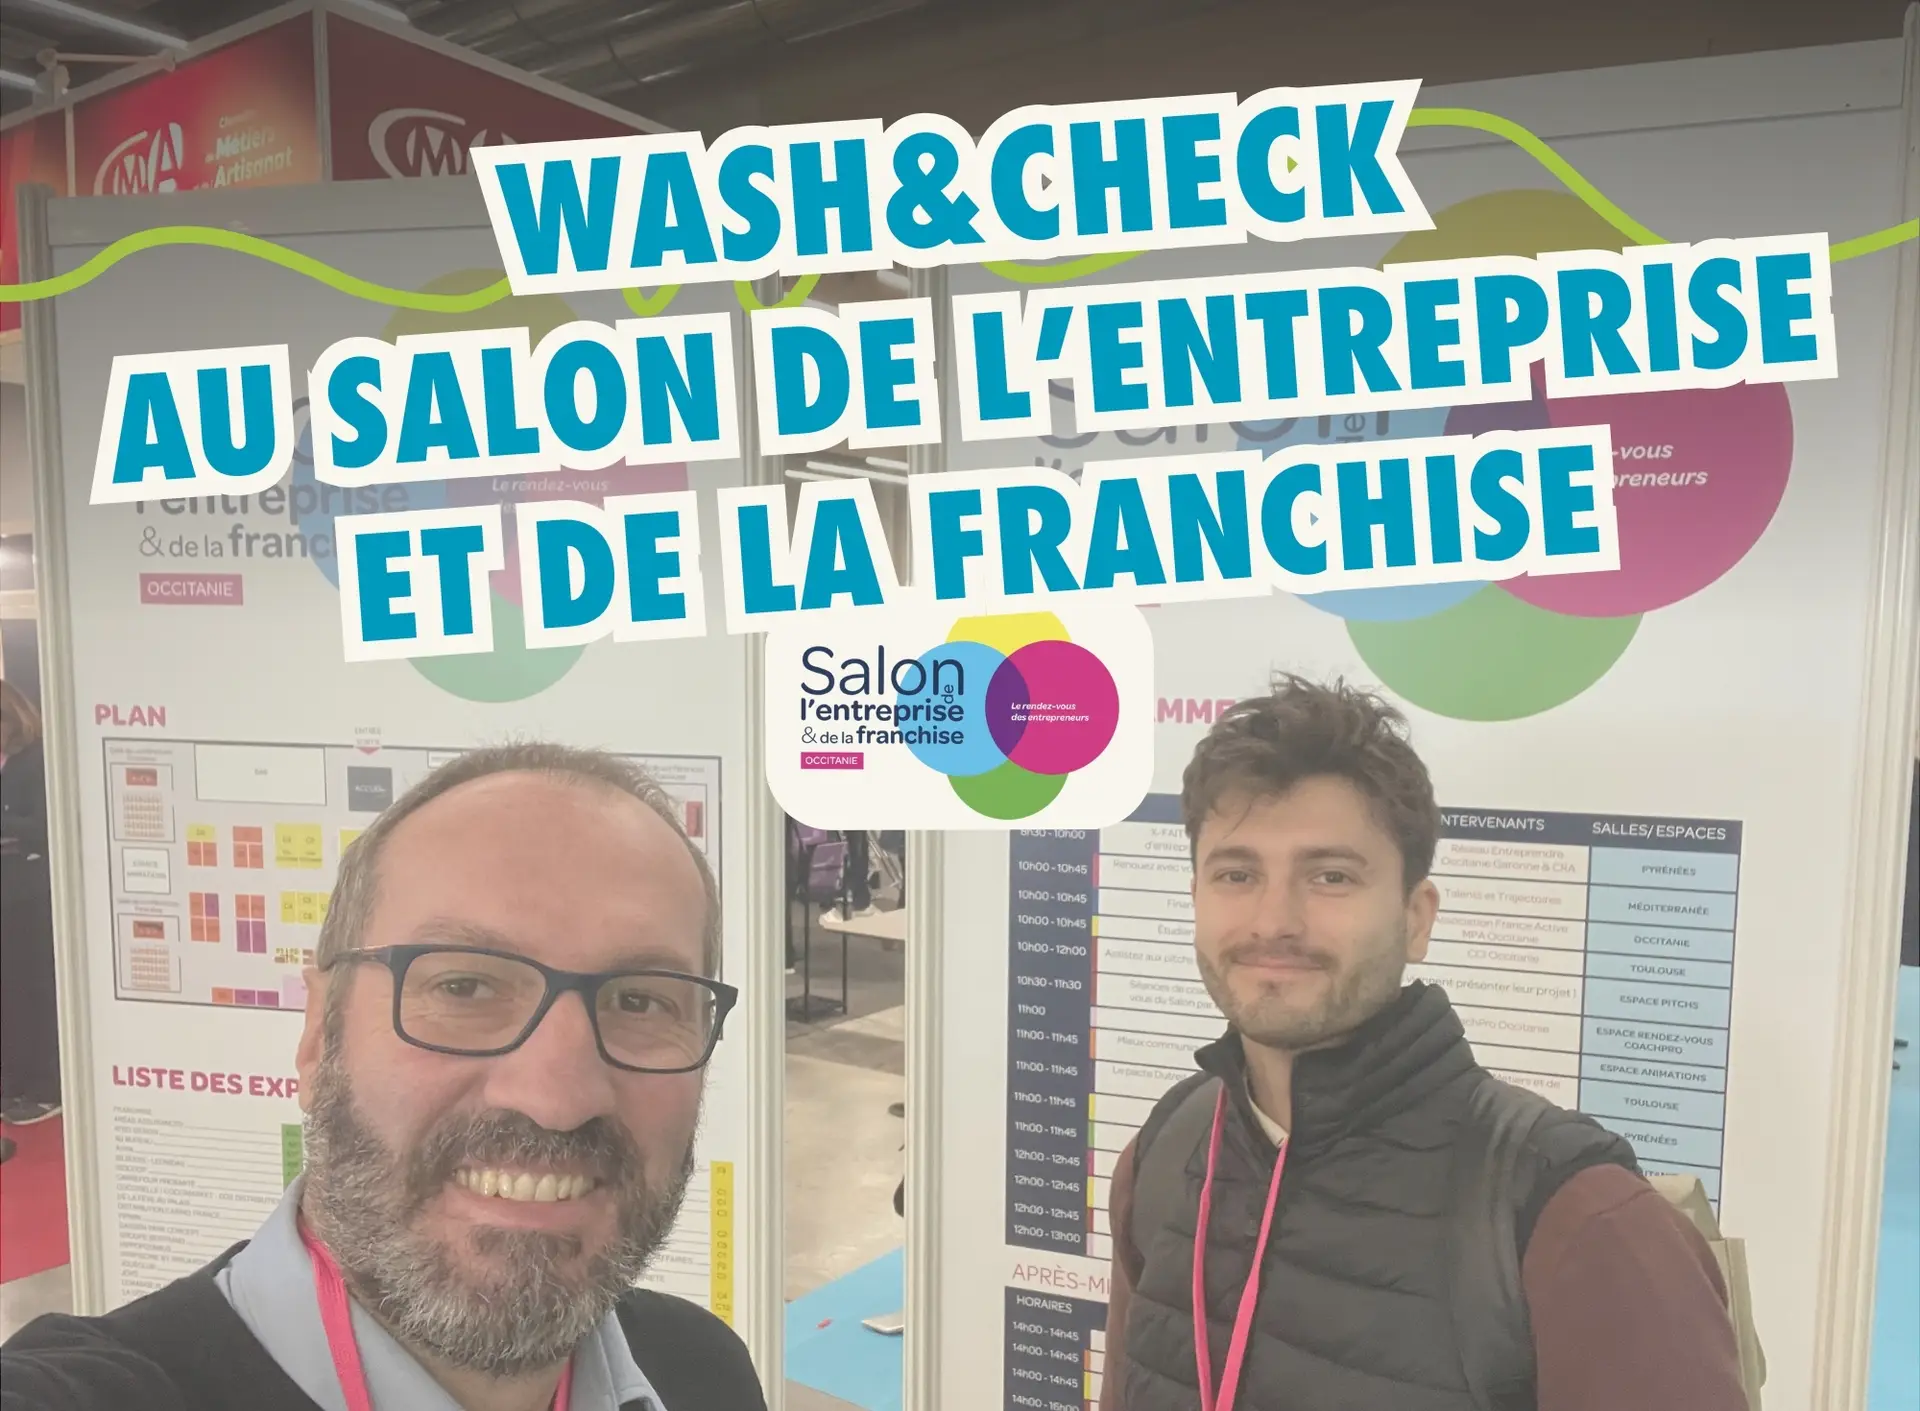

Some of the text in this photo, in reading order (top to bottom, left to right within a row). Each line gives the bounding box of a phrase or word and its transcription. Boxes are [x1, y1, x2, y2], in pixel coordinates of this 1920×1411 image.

[214, 147, 293, 189] Artisanat
[139, 526, 165, 557] &
[169, 535, 198, 557] de
[204, 534, 223, 557] la
[147, 581, 234, 597] OCCITANIE
[94, 703, 167, 727] PLAN
[1018, 861, 1088, 875] 10h00 10h45
[1018, 890, 1087, 904] 10h00 10h45
[1628, 902, 1709, 916] MÉDITERRANÉE
[1018, 914, 1087, 929] 10h00 10h45
[1534, 923, 1569, 933] Active
[1018, 942, 1087, 957] 10h00 12h00
[1634, 935, 1690, 948] OCCITANIE
[1631, 964, 1686, 976] TOULOUSE
[1017, 976, 1082, 990] 10h30 11h30
[1456, 980, 1510, 993] présenter
[1536, 986, 1571, 1000] projet
[1620, 995, 1659, 1006] ESPACE
[1018, 1004, 1046, 1015] 11h00
[1016, 1029, 1078, 1044] 11h00 11h45
[1596, 1027, 1714, 1046] ESPACE RENDEZ-VOUS
[1624, 1041, 1683, 1054] COACHPRO
[1016, 1061, 1078, 1076] 11h00 11h45
[1600, 1063, 1707, 1082] ESPACE ANIMATIONS
[113, 1065, 185, 1091] LISTE
[191, 1071, 243, 1095] DES
[1014, 1092, 1076, 1108] 11h00 11h45
[1624, 1097, 1680, 1111] TOULOUSE
[1015, 1121, 1077, 1138] 11h00 11h45
[1014, 1149, 1080, 1167] 12h00 12h45
[1014, 1175, 1080, 1193] 12h00 12h45
[1014, 1203, 1080, 1221] 12h00 12h45
[1013, 1225, 1081, 1243] 12h00 13h00
[1016, 1295, 1072, 1314] HORAIRES
[1012, 1321, 1079, 1341] 14h00 14h45
[1012, 1343, 1079, 1363] 14h00 14h45
[1012, 1368, 1078, 1389] 14h00 14h45
